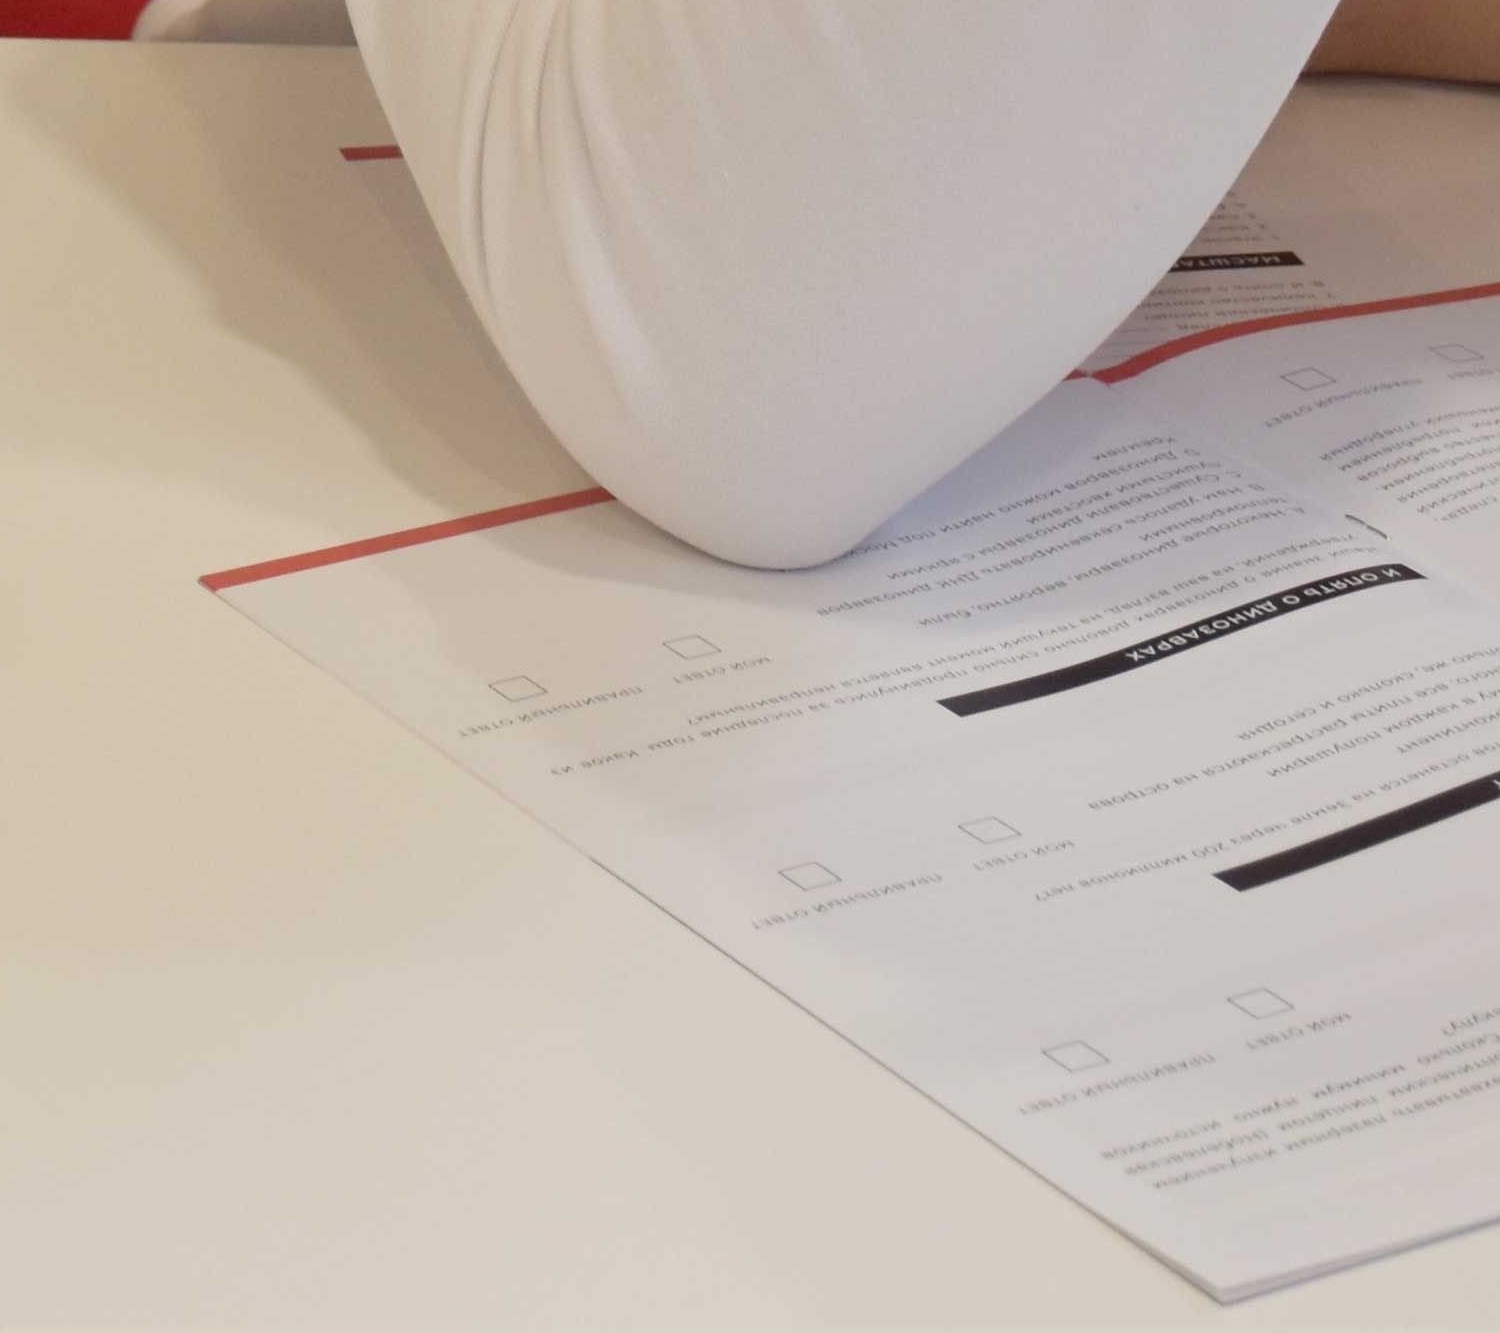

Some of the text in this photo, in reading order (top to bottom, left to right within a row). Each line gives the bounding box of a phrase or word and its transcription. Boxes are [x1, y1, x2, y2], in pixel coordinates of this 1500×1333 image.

[1174, 253, 1280, 267] МАСШТА
[1119, 567, 1399, 662] И ОПЯТЬ О ДИНОЗАВРАХ
[668, 656, 773, 684] МОЙ ОТВЕТ
[453, 685, 648, 737] ПРАВИЛЬНЫЙ ОТВЕТ
[968, 840, 1078, 871] МОЙ ОТВЕТ
[746, 873, 946, 930] ПРАВИЛЬНЫЙ ОТВЕТ
[1241, 1013, 1354, 1049] МОЙ ОТВЕТ
[1014, 1053, 1220, 1114] ПРАВИЛЬНЫЙ ОТВЕТ
